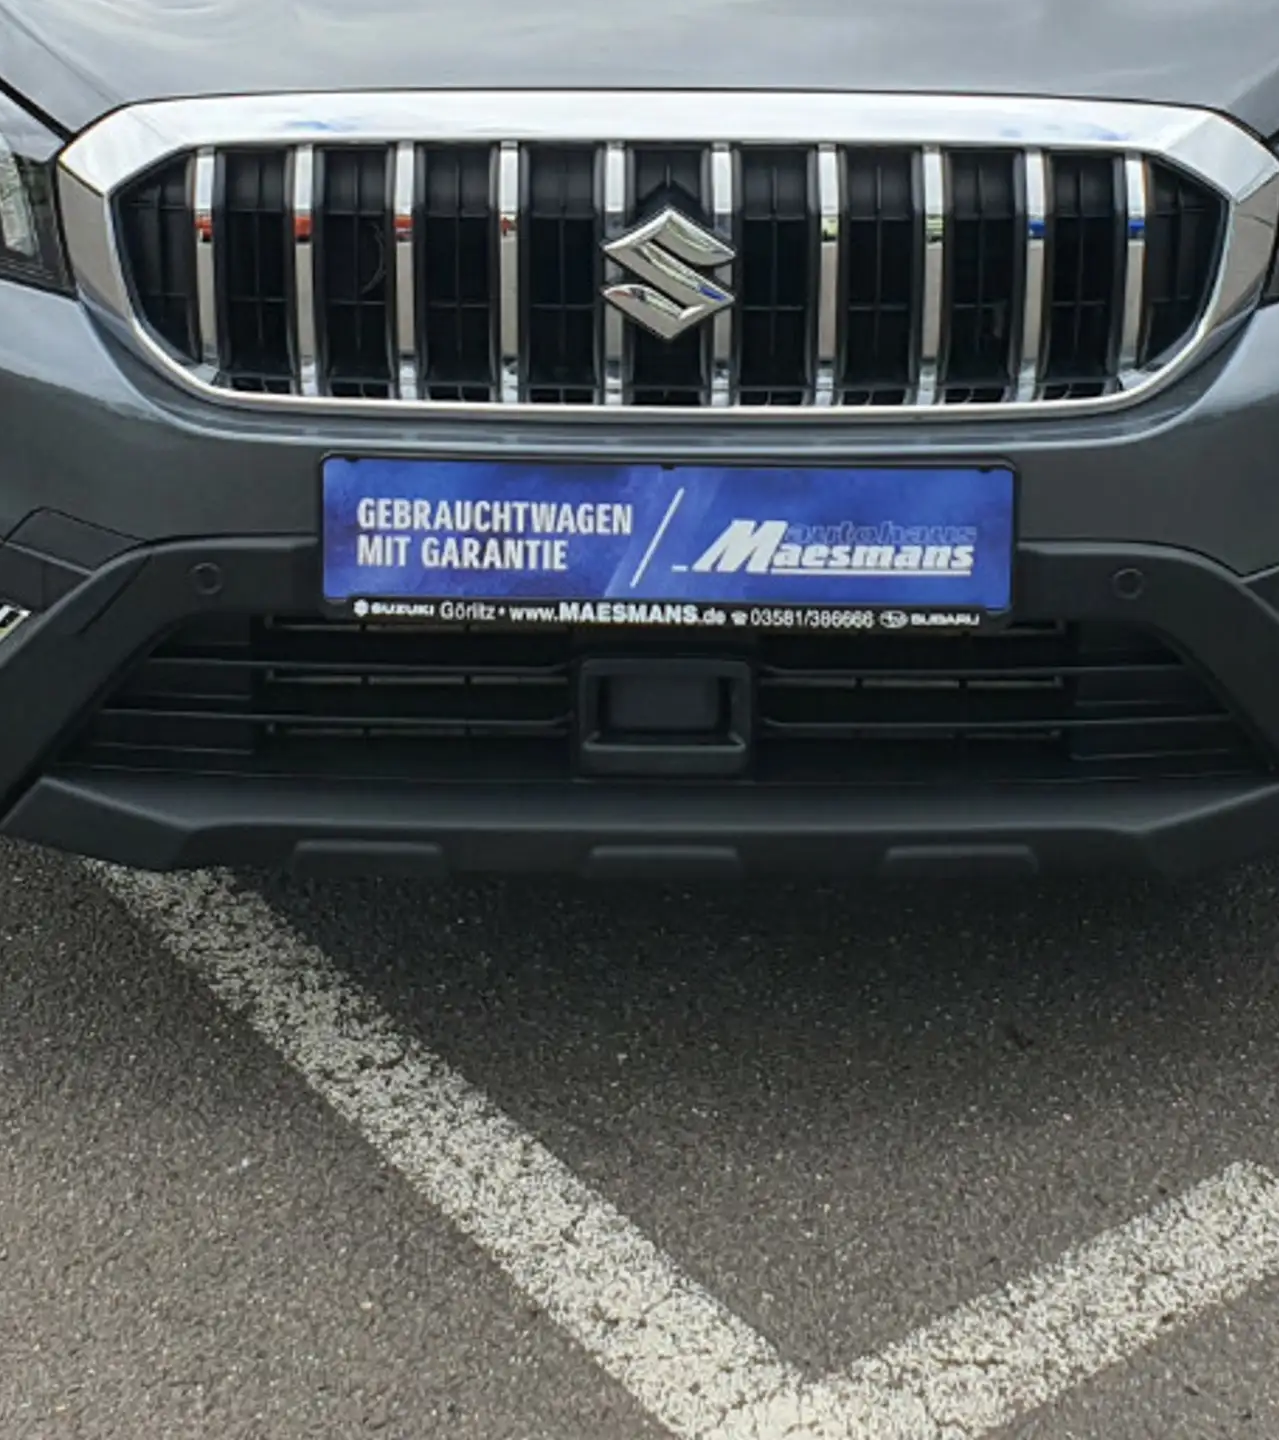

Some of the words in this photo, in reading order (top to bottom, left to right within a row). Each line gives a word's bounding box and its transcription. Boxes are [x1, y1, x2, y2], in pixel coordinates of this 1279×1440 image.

[357, 498, 633, 536] GEBRAUCHTWAGEN
[357, 534, 410, 567] MIT
[421, 536, 568, 570] GARANTIE
[692, 520, 976, 573] Maesmans
[371, 603, 435, 616] SUZUKI
[440, 600, 496, 620] Görlitz
[510, 602, 726, 625] www.MAESMANS.de
[911, 613, 980, 626] SUBARU
